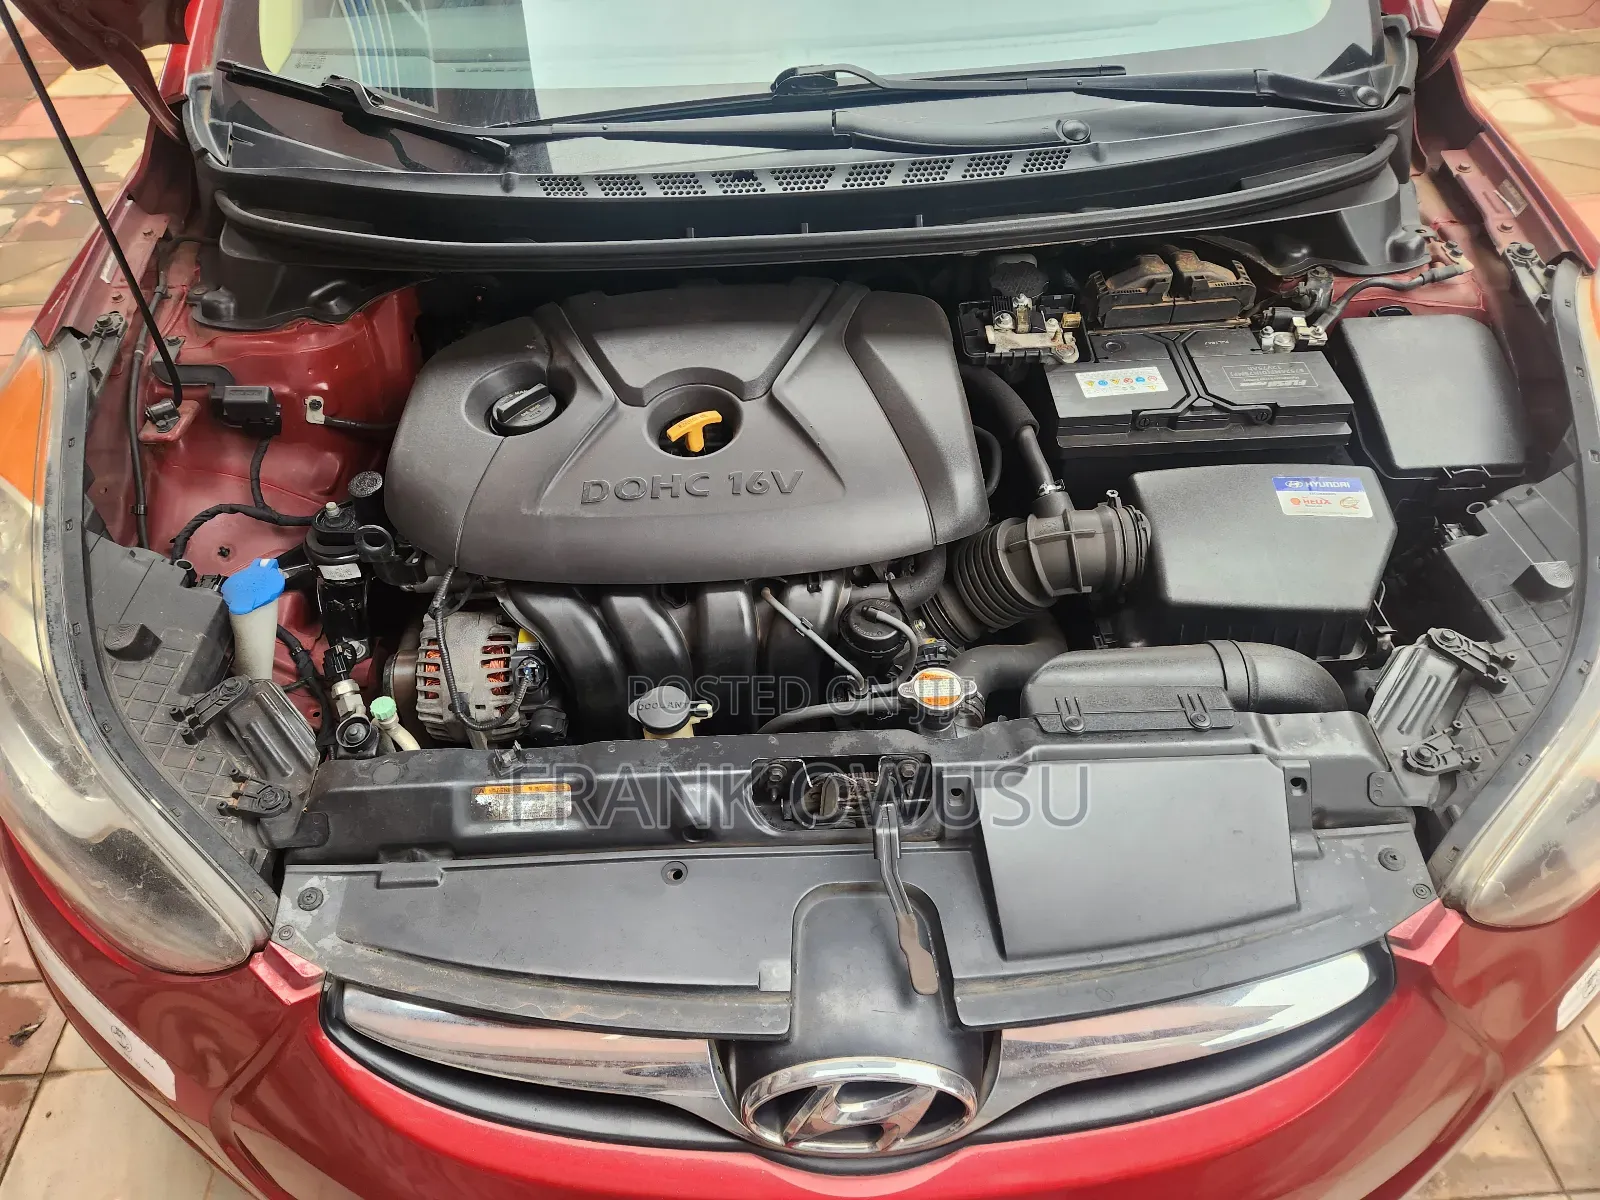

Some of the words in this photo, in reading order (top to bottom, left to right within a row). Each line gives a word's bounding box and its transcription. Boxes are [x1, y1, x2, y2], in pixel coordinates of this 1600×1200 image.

[580, 472, 710, 504] DOHC
[728, 470, 804, 495] 16V
[1304, 480, 1351, 488] HYUNDAI
